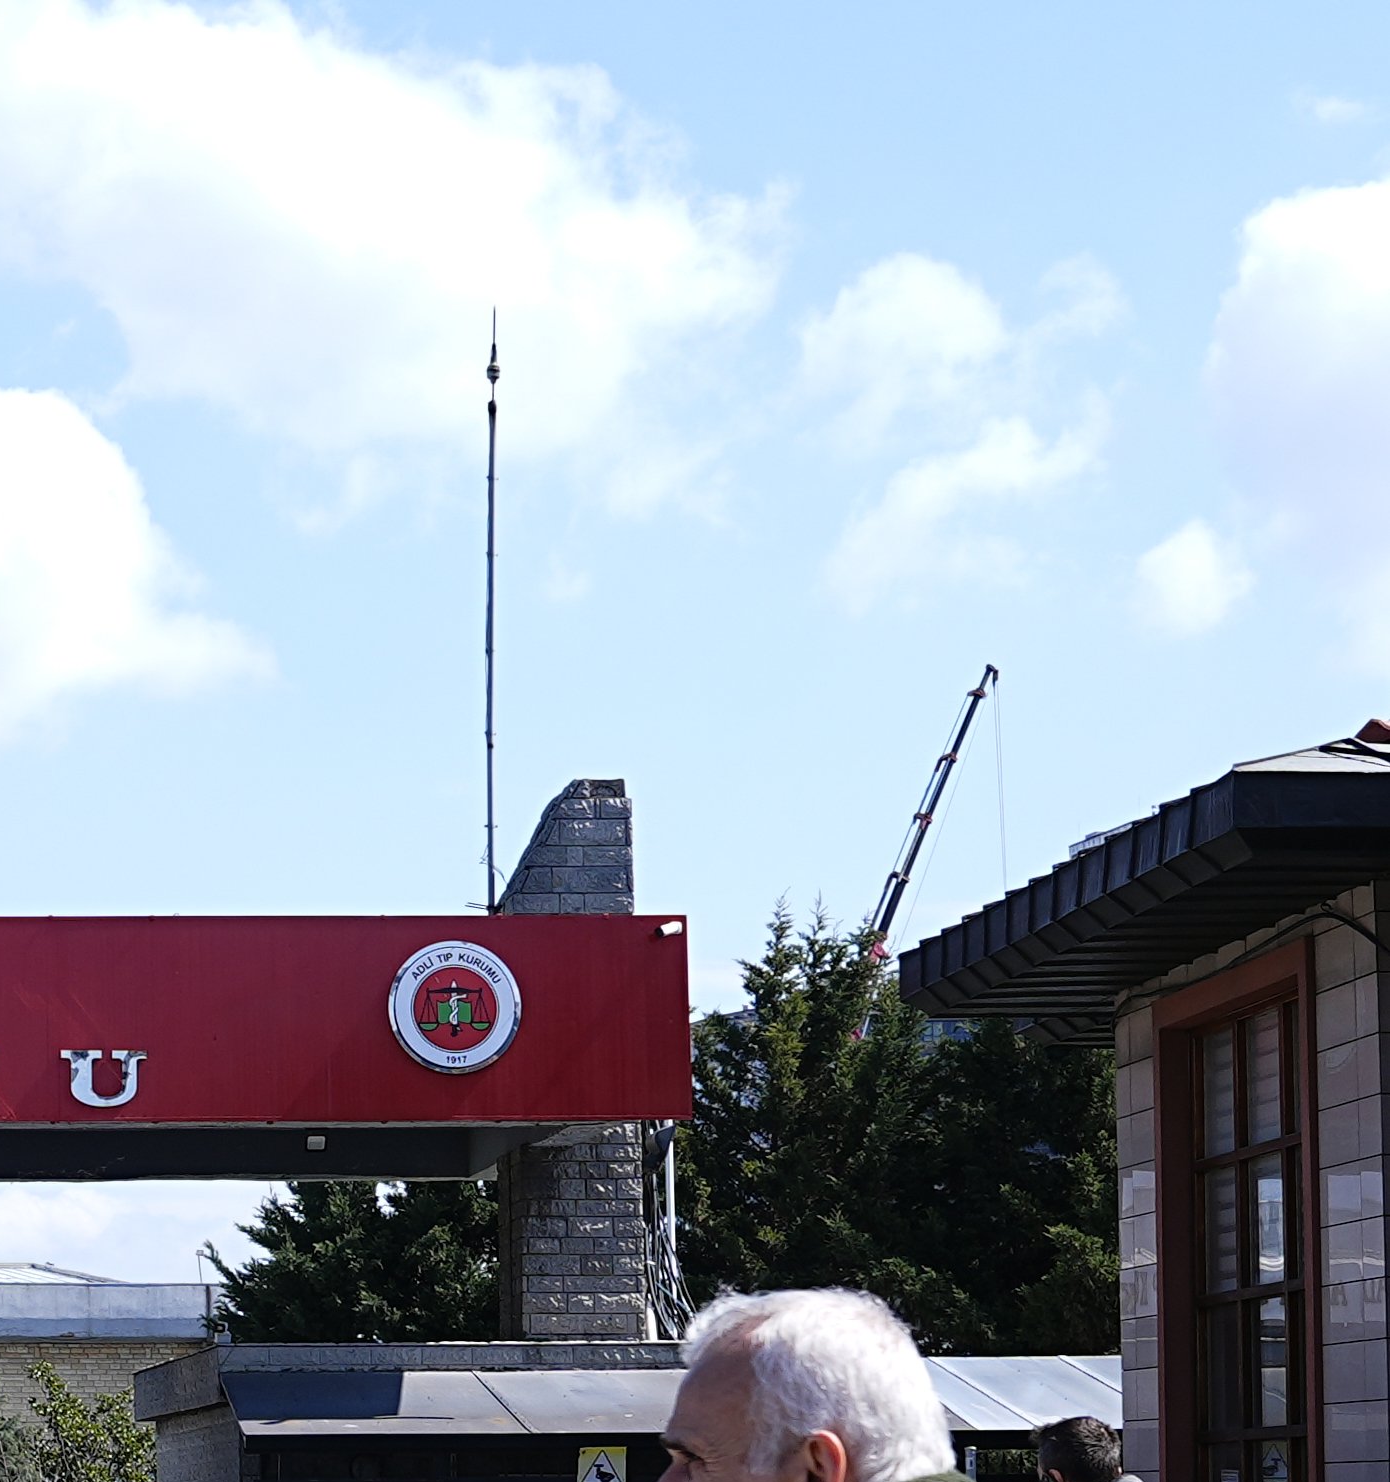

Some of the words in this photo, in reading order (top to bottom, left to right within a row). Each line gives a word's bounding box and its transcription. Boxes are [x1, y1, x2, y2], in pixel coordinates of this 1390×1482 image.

[411, 958, 434, 981] ADLİ
[436, 952, 454, 965] TIP
[458, 952, 502, 984] KURUMU
[446, 1055, 468, 1065] 1917
